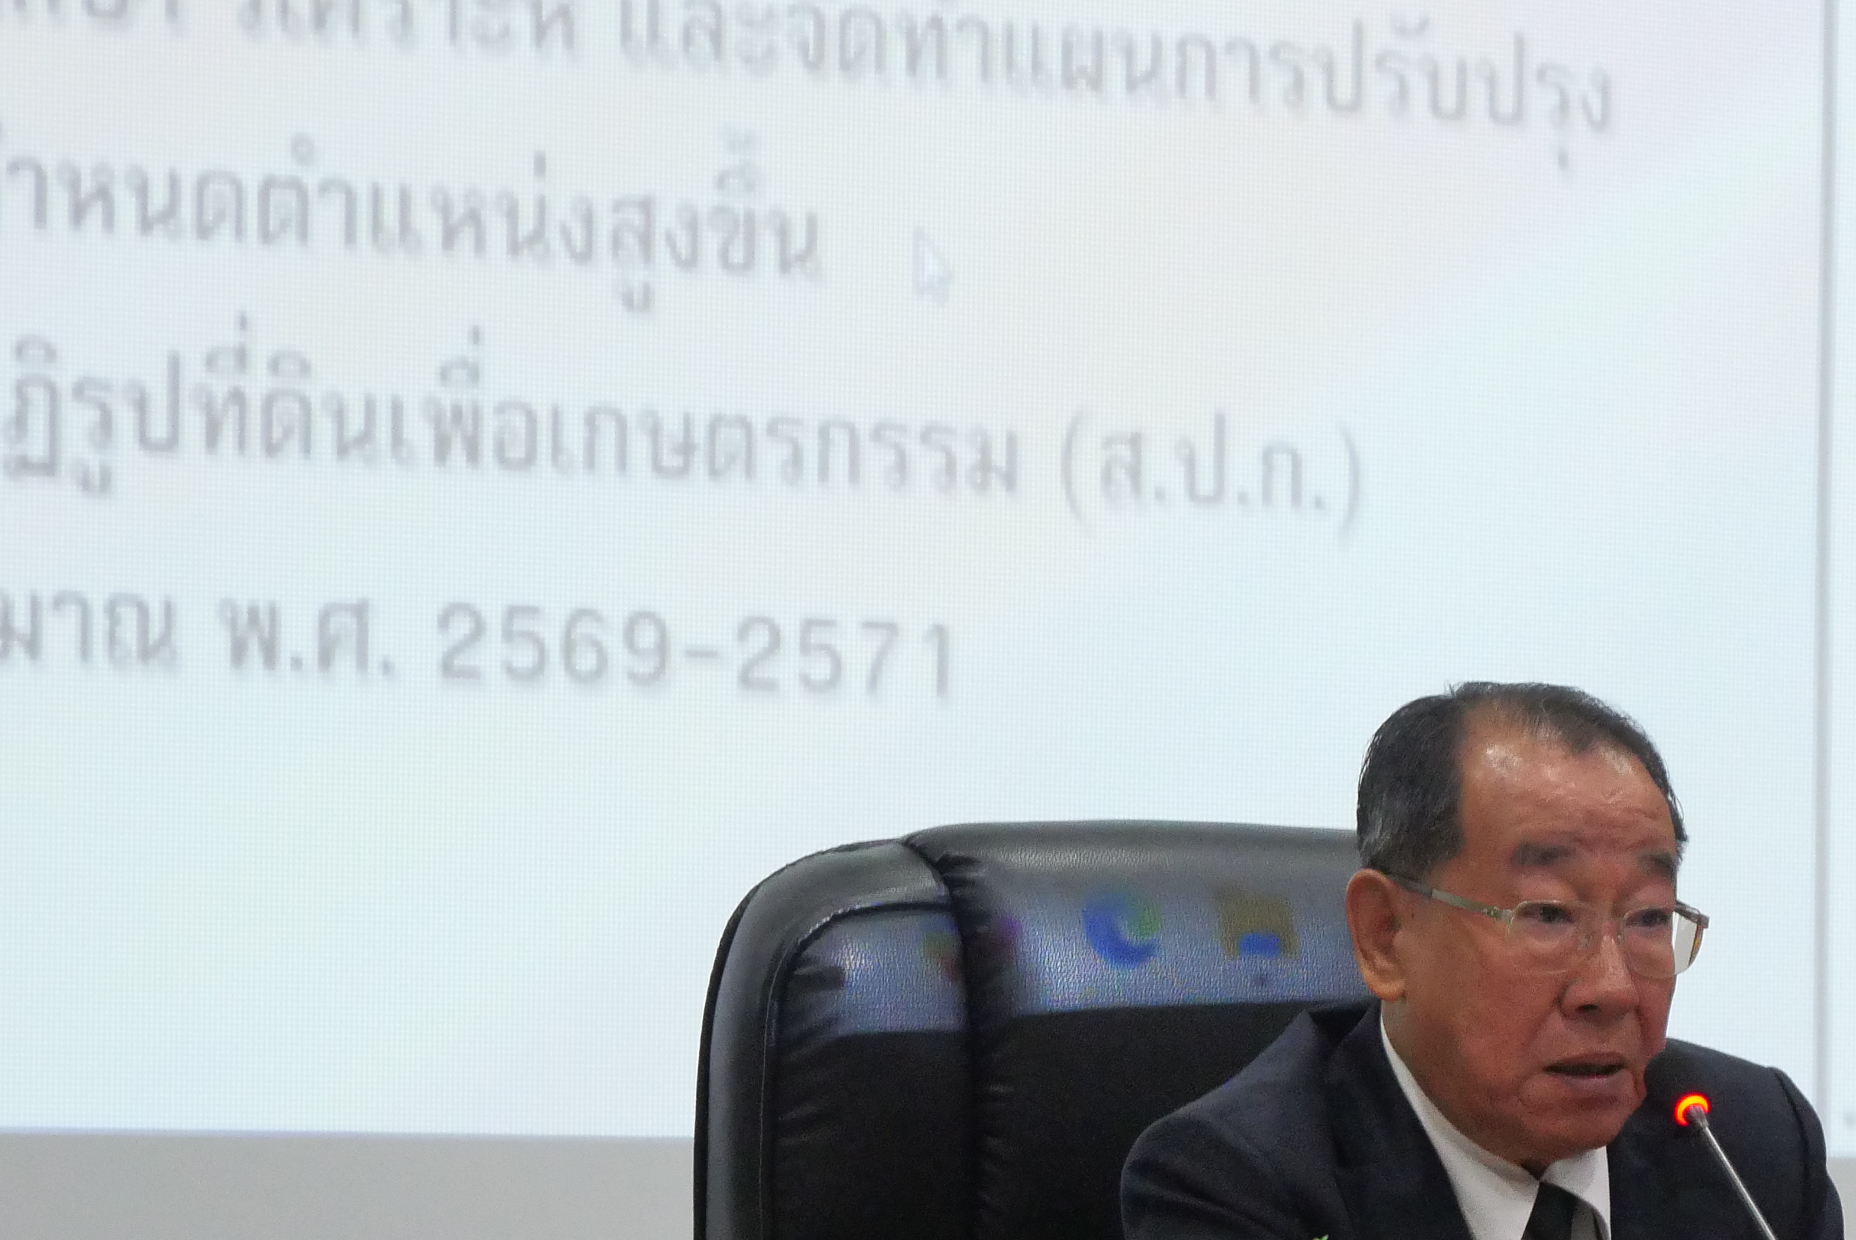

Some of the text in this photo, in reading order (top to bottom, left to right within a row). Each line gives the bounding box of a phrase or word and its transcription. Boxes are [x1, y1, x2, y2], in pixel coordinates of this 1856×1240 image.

[1060, 408, 1364, 546] (ส.ป.ก.)
[216, 595, 395, 680] พ.ศ.
[435, 600, 953, 700] 2569-2571
